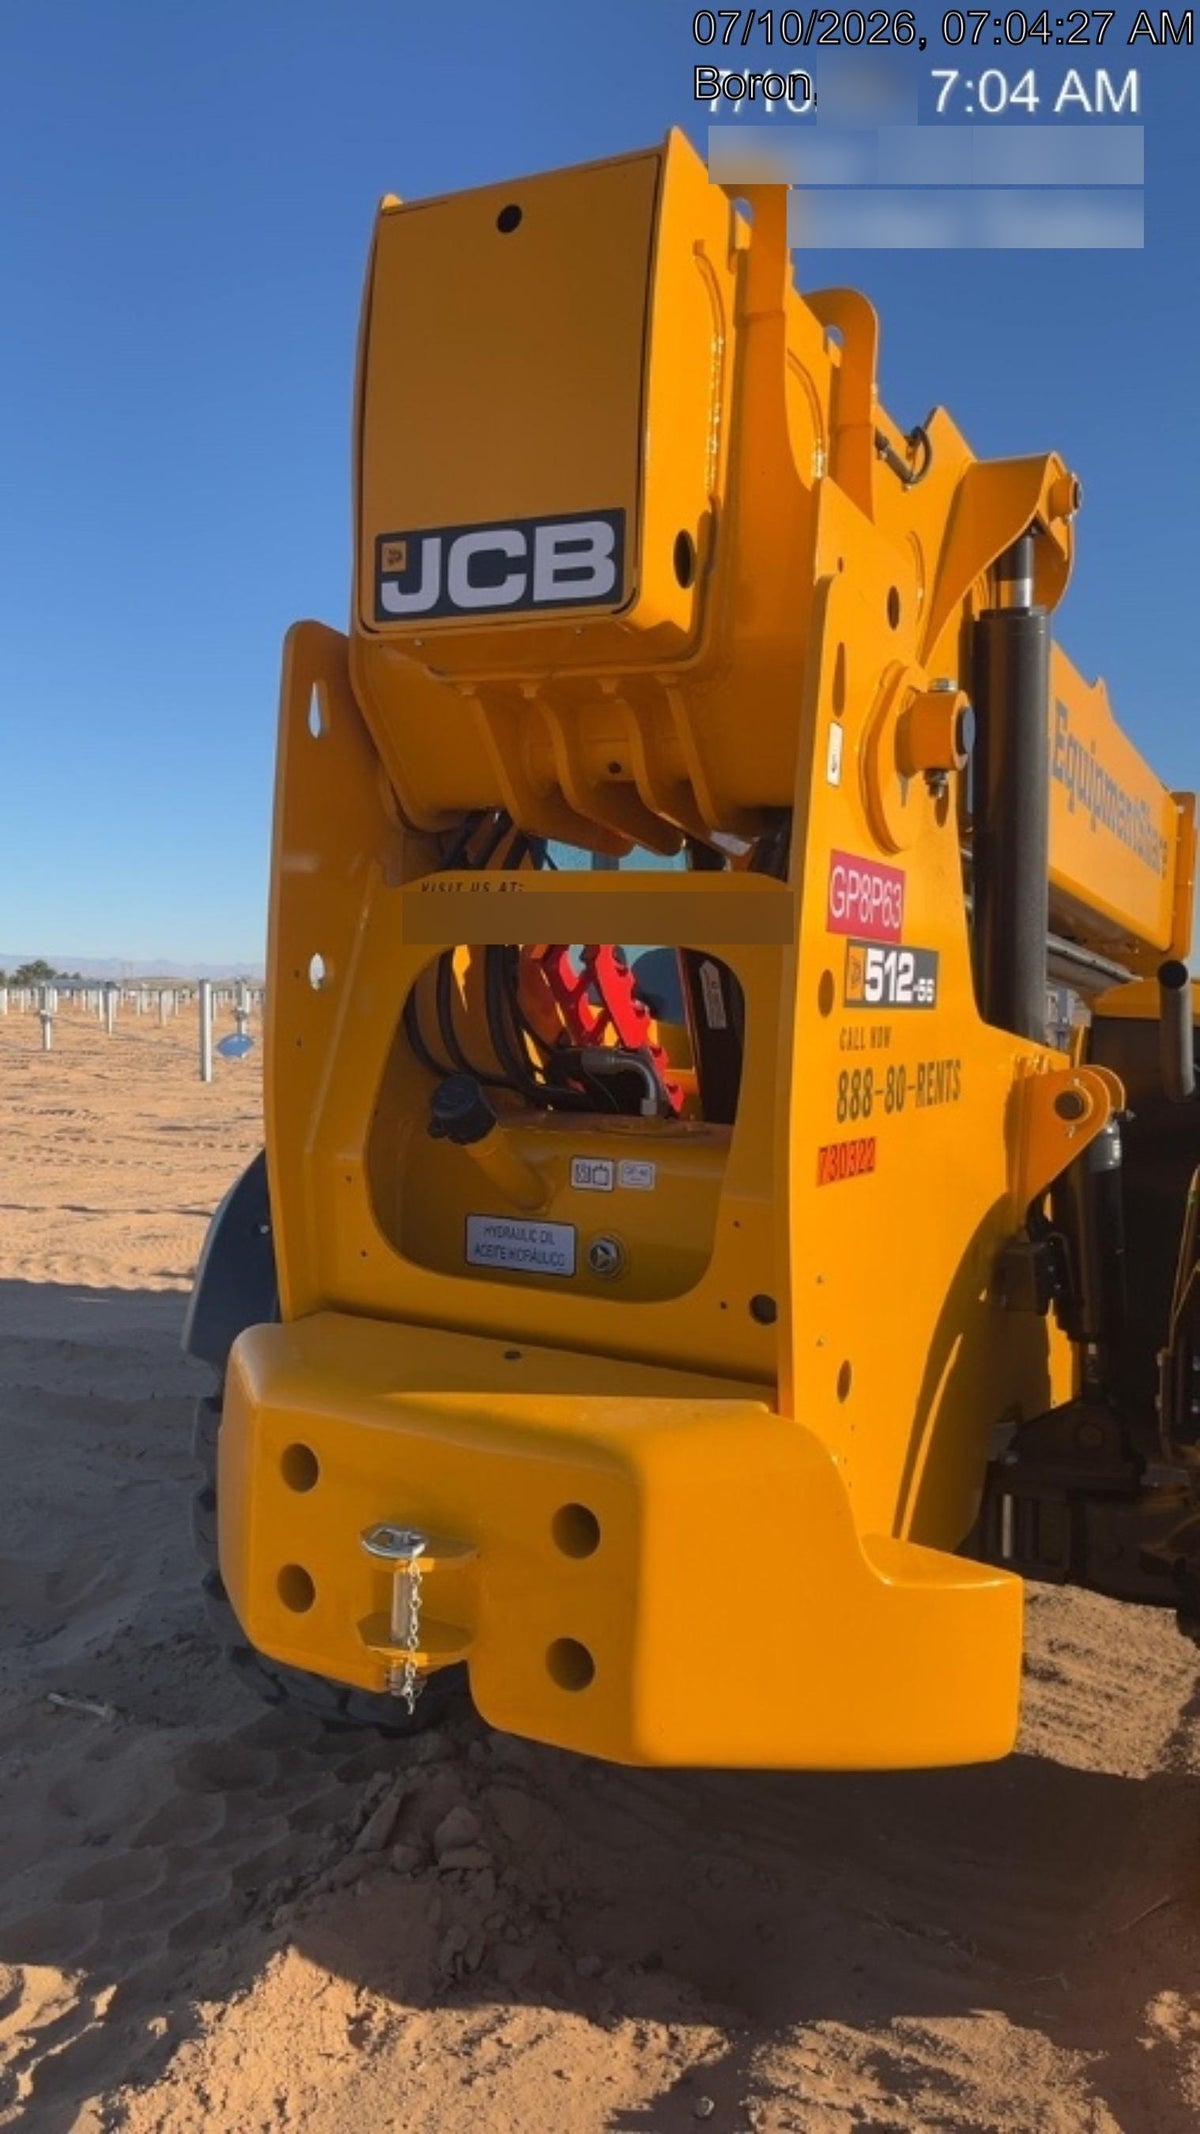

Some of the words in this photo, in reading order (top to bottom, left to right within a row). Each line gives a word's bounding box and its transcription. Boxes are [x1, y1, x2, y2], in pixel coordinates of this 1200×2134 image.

[380, 520, 616, 613] JCB
[471, 881, 490, 892] US
[830, 866, 903, 929] GP8P63
[839, 1026, 866, 1051] CALL
[870, 1026, 892, 1049] NOW
[836, 1058, 962, 1124] 888-80-RENTS
[483, 1224, 539, 1244] HYDRAULIC
